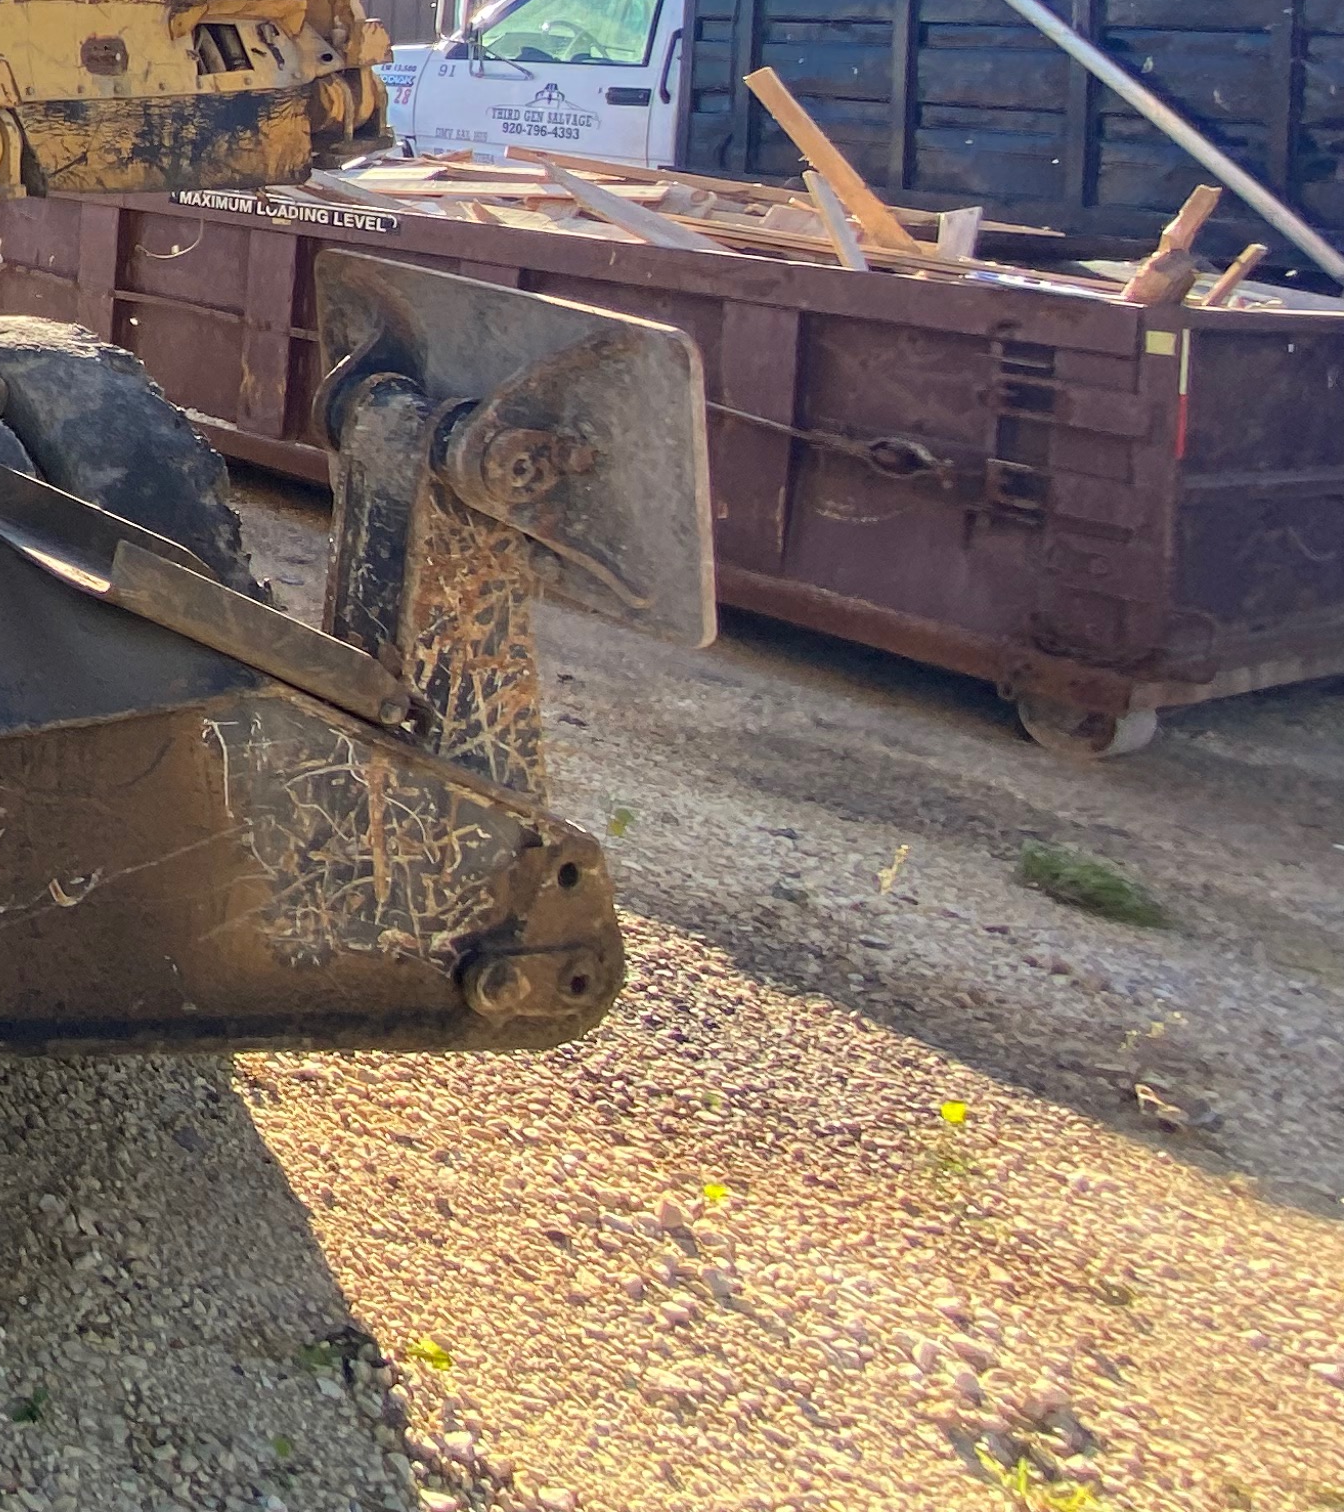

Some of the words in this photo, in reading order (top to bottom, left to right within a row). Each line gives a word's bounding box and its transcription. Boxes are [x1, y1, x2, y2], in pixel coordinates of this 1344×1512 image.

[393, 88, 412, 105] 28
[492, 107, 521, 121] THIRD
[524, 110, 544, 123] GEN
[547, 112, 593, 128] SALVAGE
[502, 122, 580, 140] 920-796-4393
[179, 191, 253, 214] MAXIMUM
[333, 211, 387, 233] LEVEL
